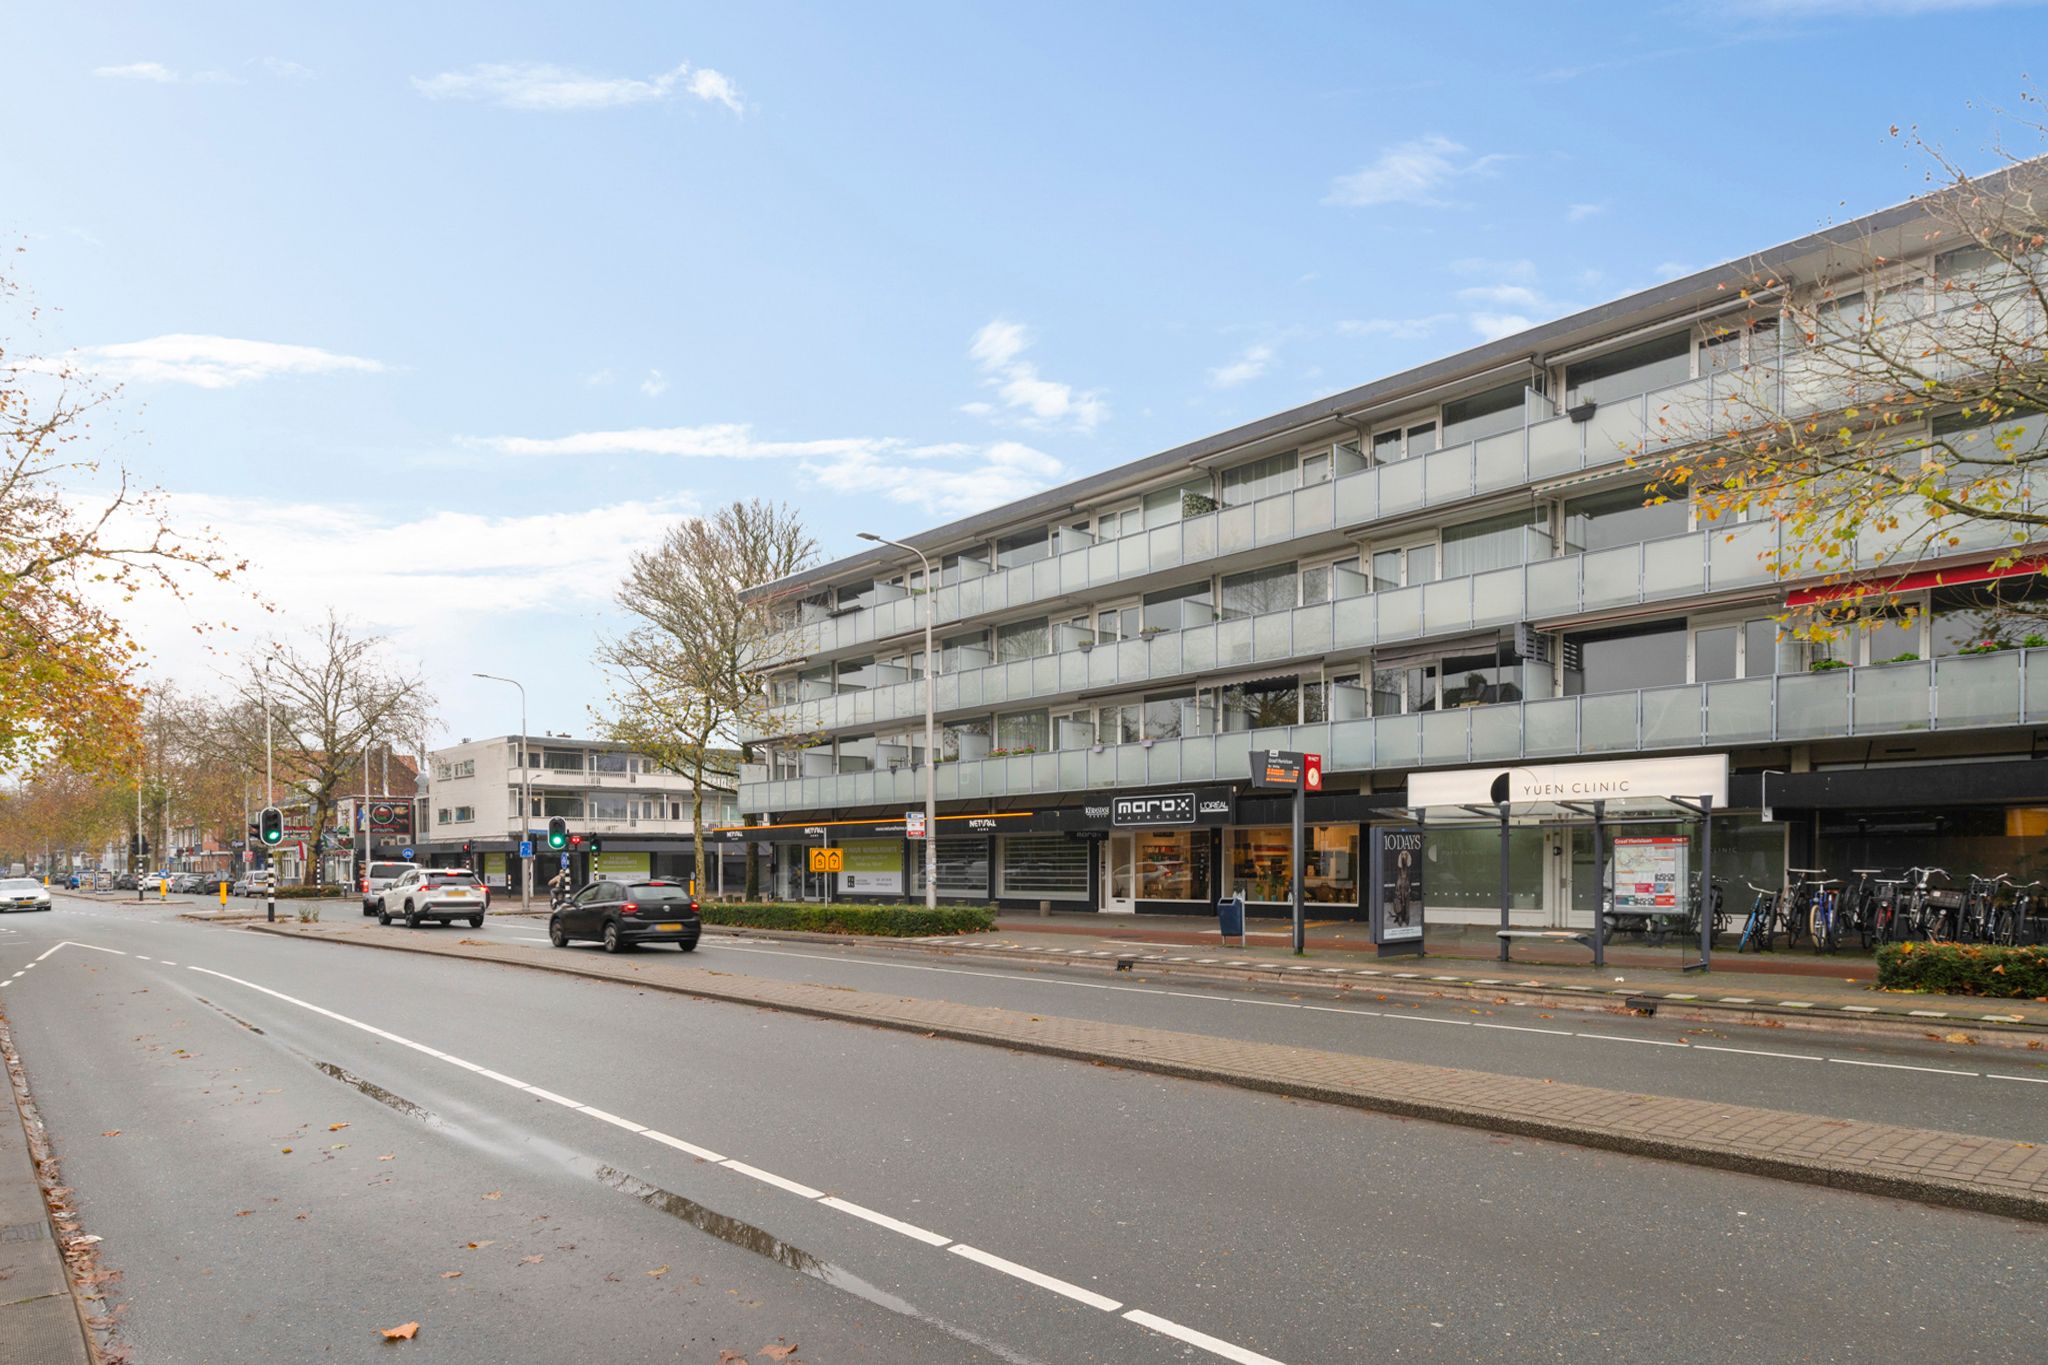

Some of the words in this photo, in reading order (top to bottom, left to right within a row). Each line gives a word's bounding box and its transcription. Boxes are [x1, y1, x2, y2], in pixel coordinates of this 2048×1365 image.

[1524, 784, 1564, 796] YUEN
[1571, 780, 1630, 793] CLINIC
[1384, 834, 1421, 850] 10DAYS
